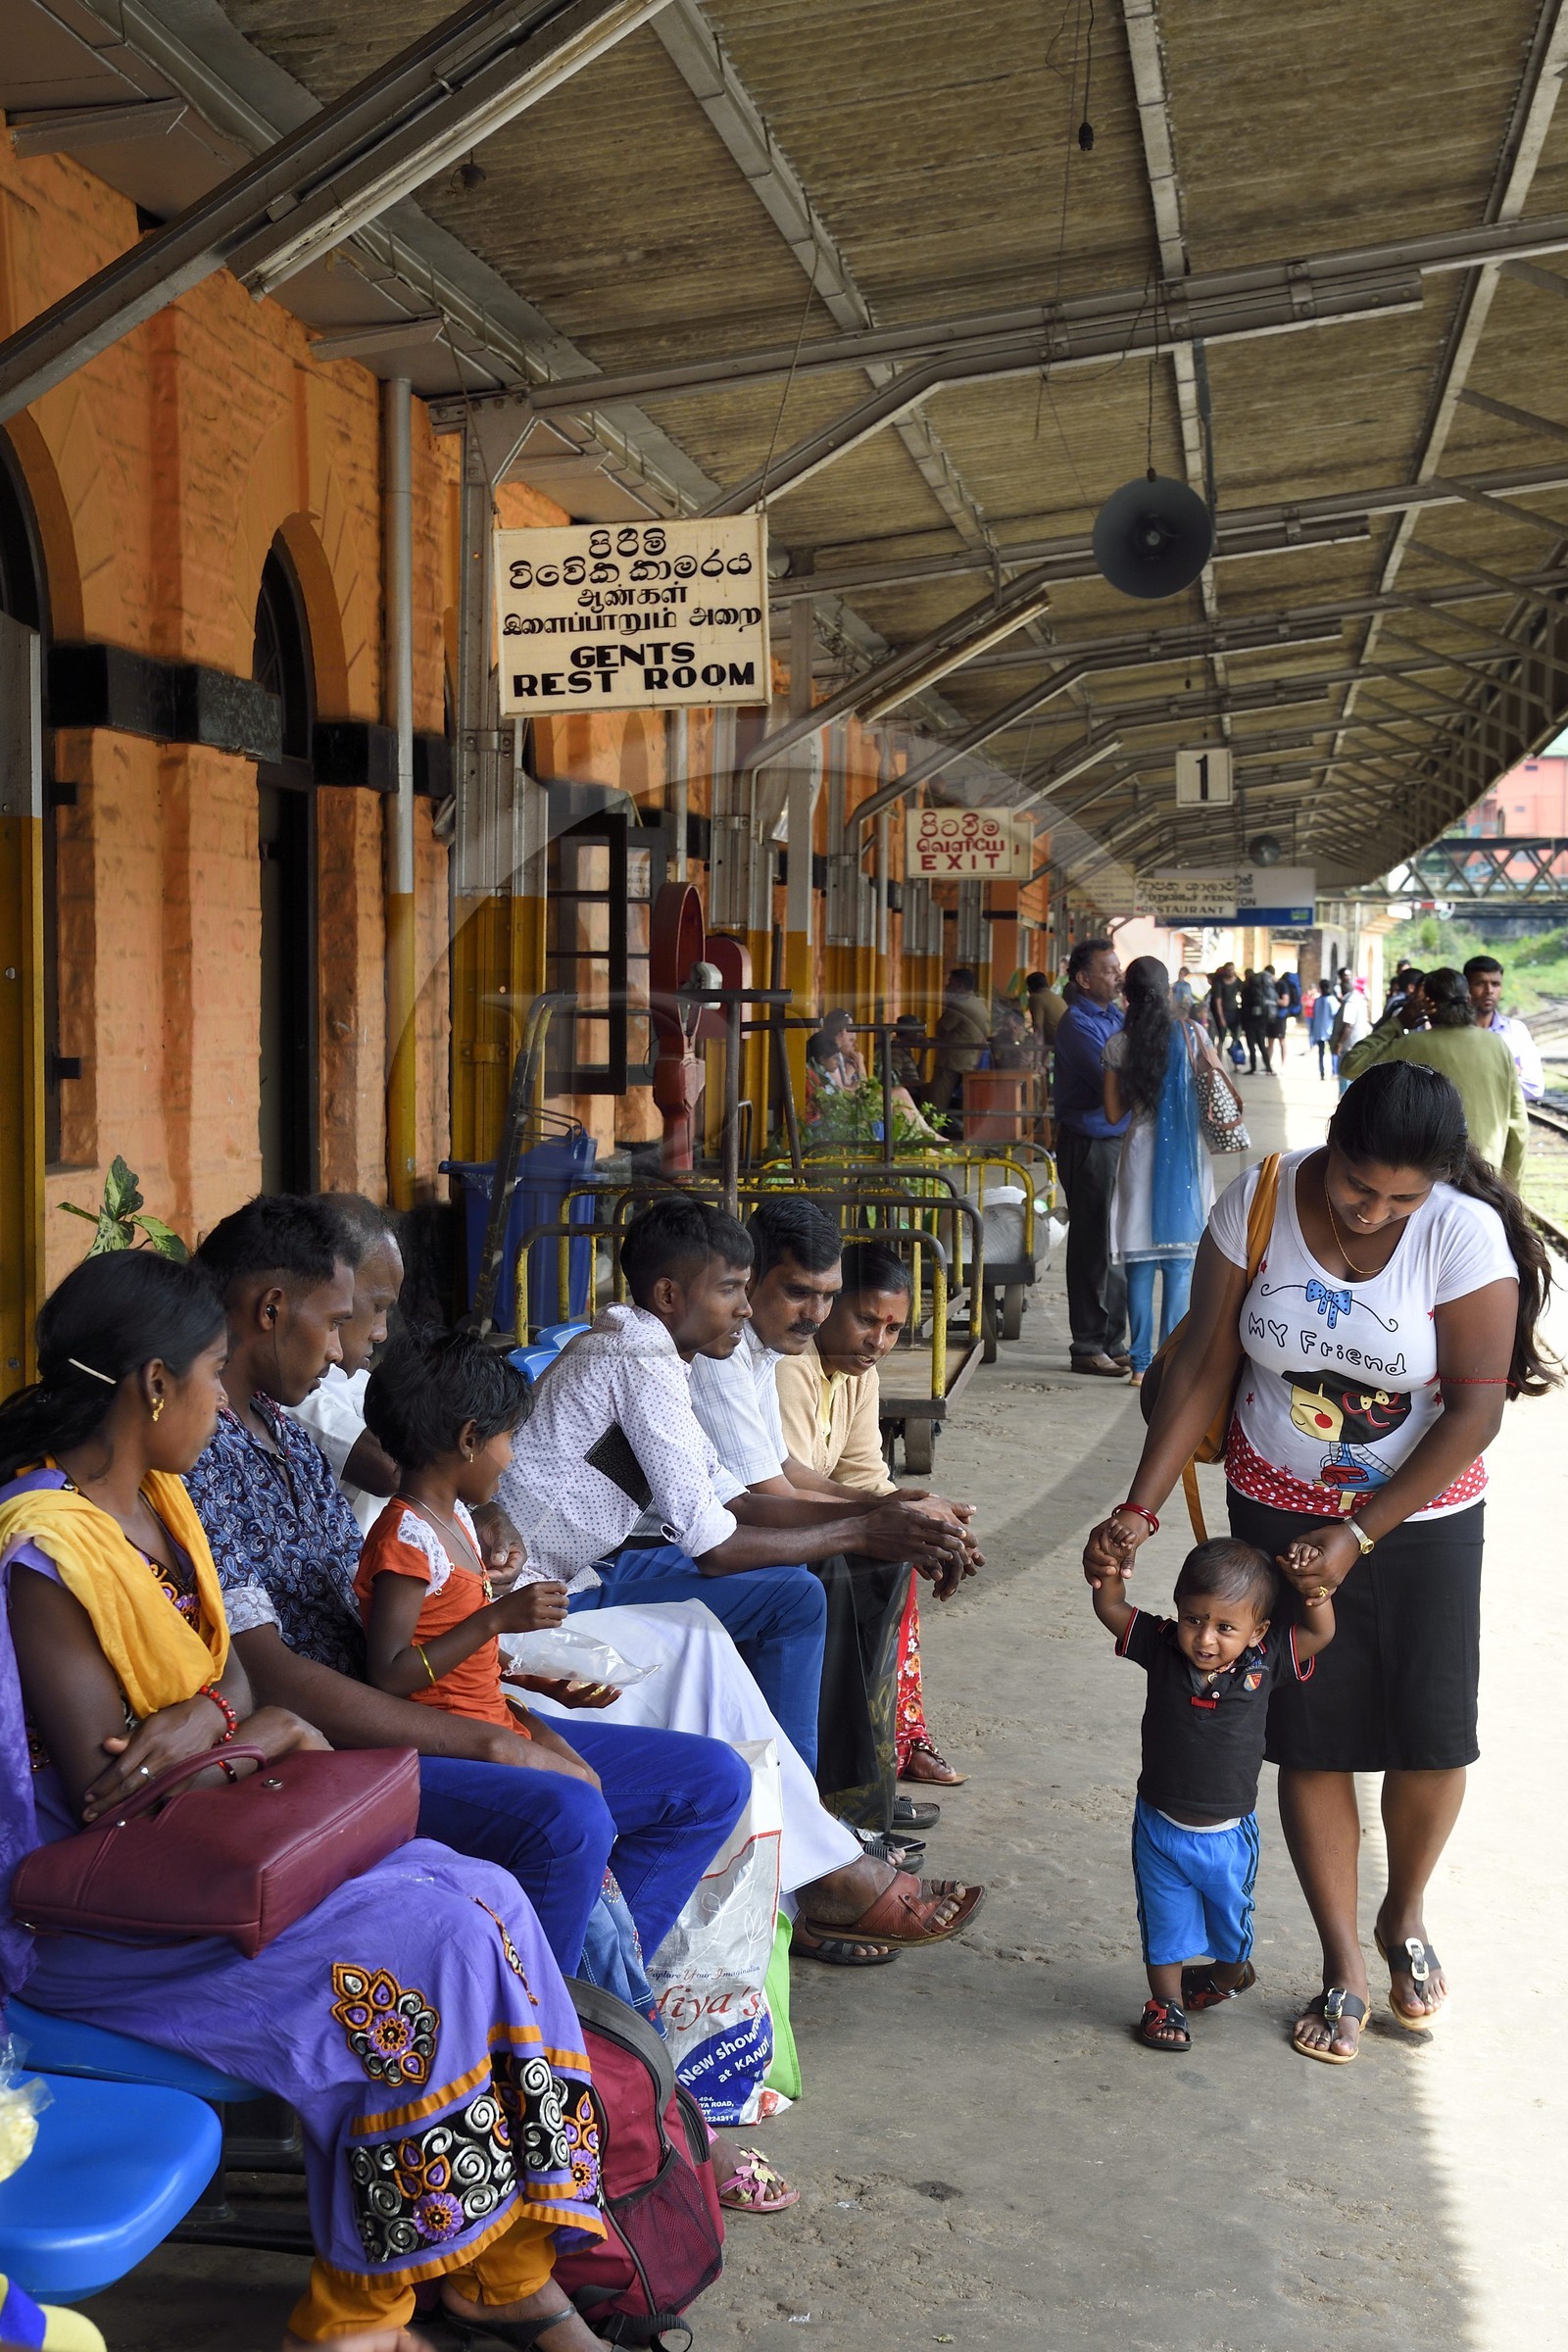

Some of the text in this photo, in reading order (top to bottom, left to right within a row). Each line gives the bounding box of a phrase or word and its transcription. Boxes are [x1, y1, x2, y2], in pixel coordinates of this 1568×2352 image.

[588, 527, 666, 560] පිරිමි
[628, 549, 754, 582] කාමරය
[577, 580, 688, 613] ஆண்கள்
[688, 607, 762, 633] அறை
[569, 641, 696, 669] GENTS
[513, 662, 755, 698] REST ROOM
[1195, 754, 1208, 801] 1
[920, 854, 1001, 871] EXIT
[1141, 906, 1225, 914] RESTAURANT
[1248, 1311, 1407, 1376] MY Friend
[683, 1968, 712, 1984] Your
[711, 1965, 760, 1981] Imagination
[677, 2054, 715, 2087] New
[717, 2069, 733, 2083] at
